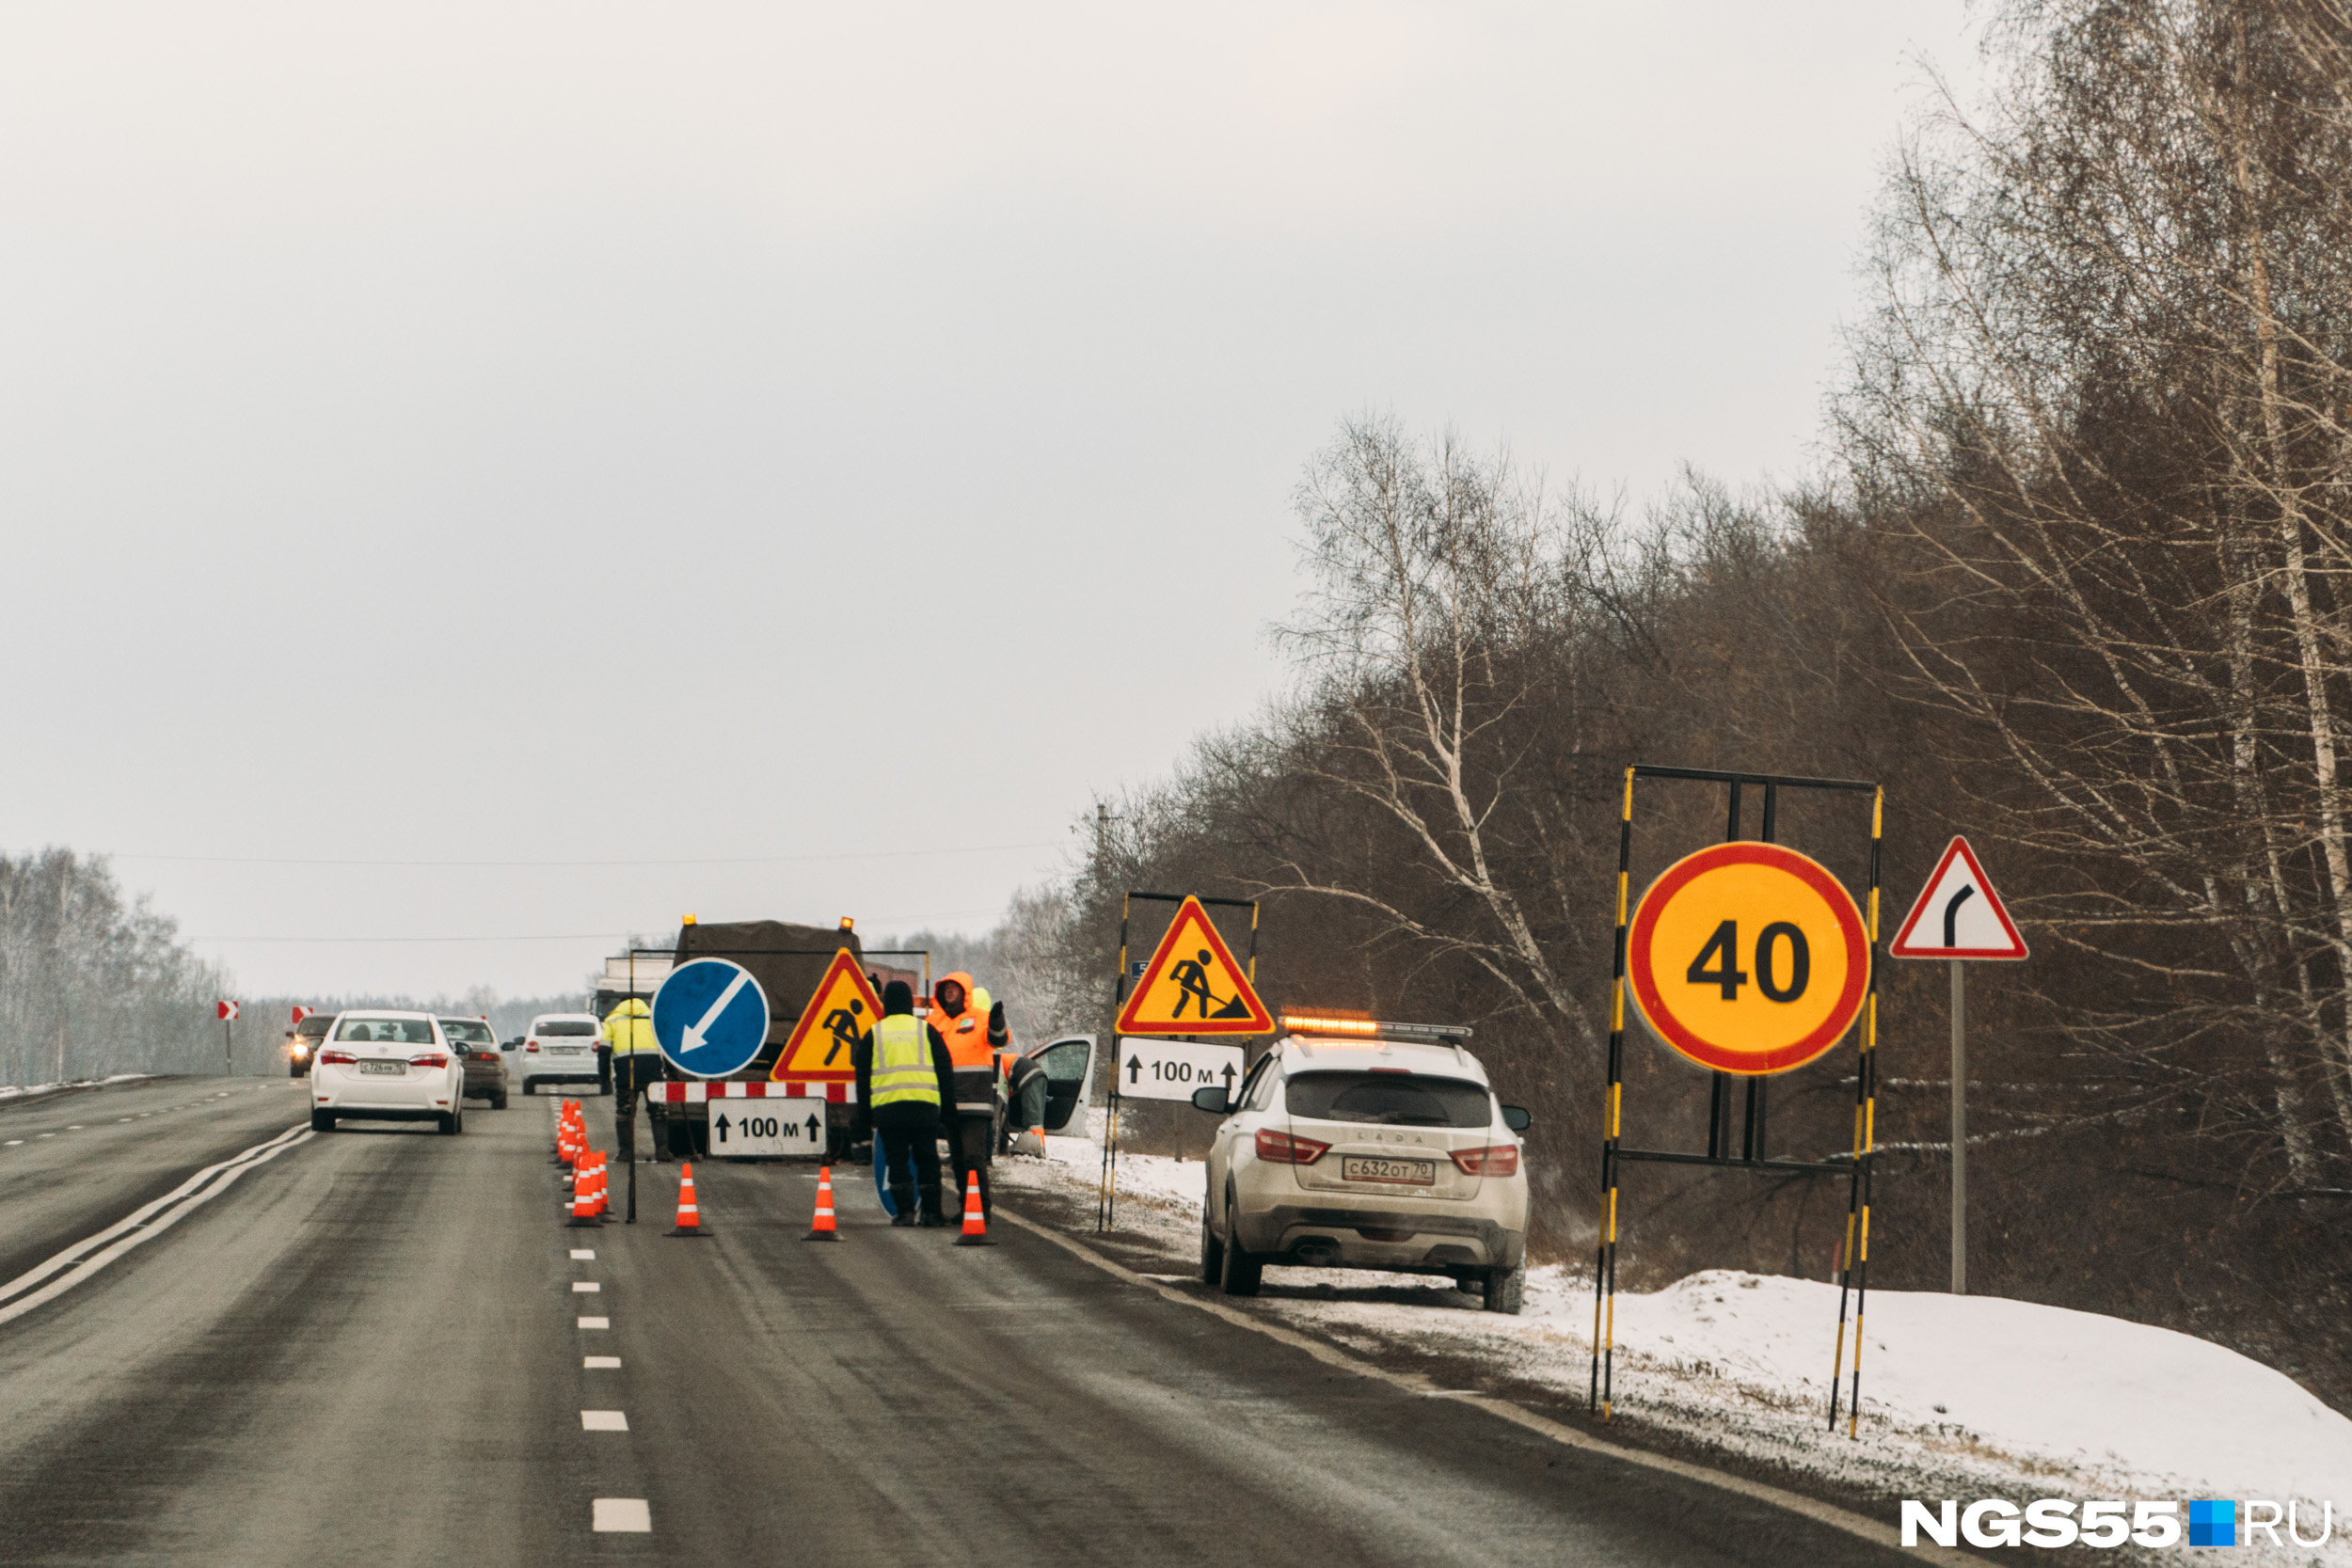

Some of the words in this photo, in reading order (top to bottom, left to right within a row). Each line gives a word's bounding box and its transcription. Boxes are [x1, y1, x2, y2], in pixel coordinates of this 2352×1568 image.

[1687, 919, 1810, 1004] 40
[1152, 1060, 1192, 1083] 100
[739, 1117, 778, 1137] 100
[1358, 1132, 1422, 1144] LADA
[1414, 1163, 1428, 1176] 70
